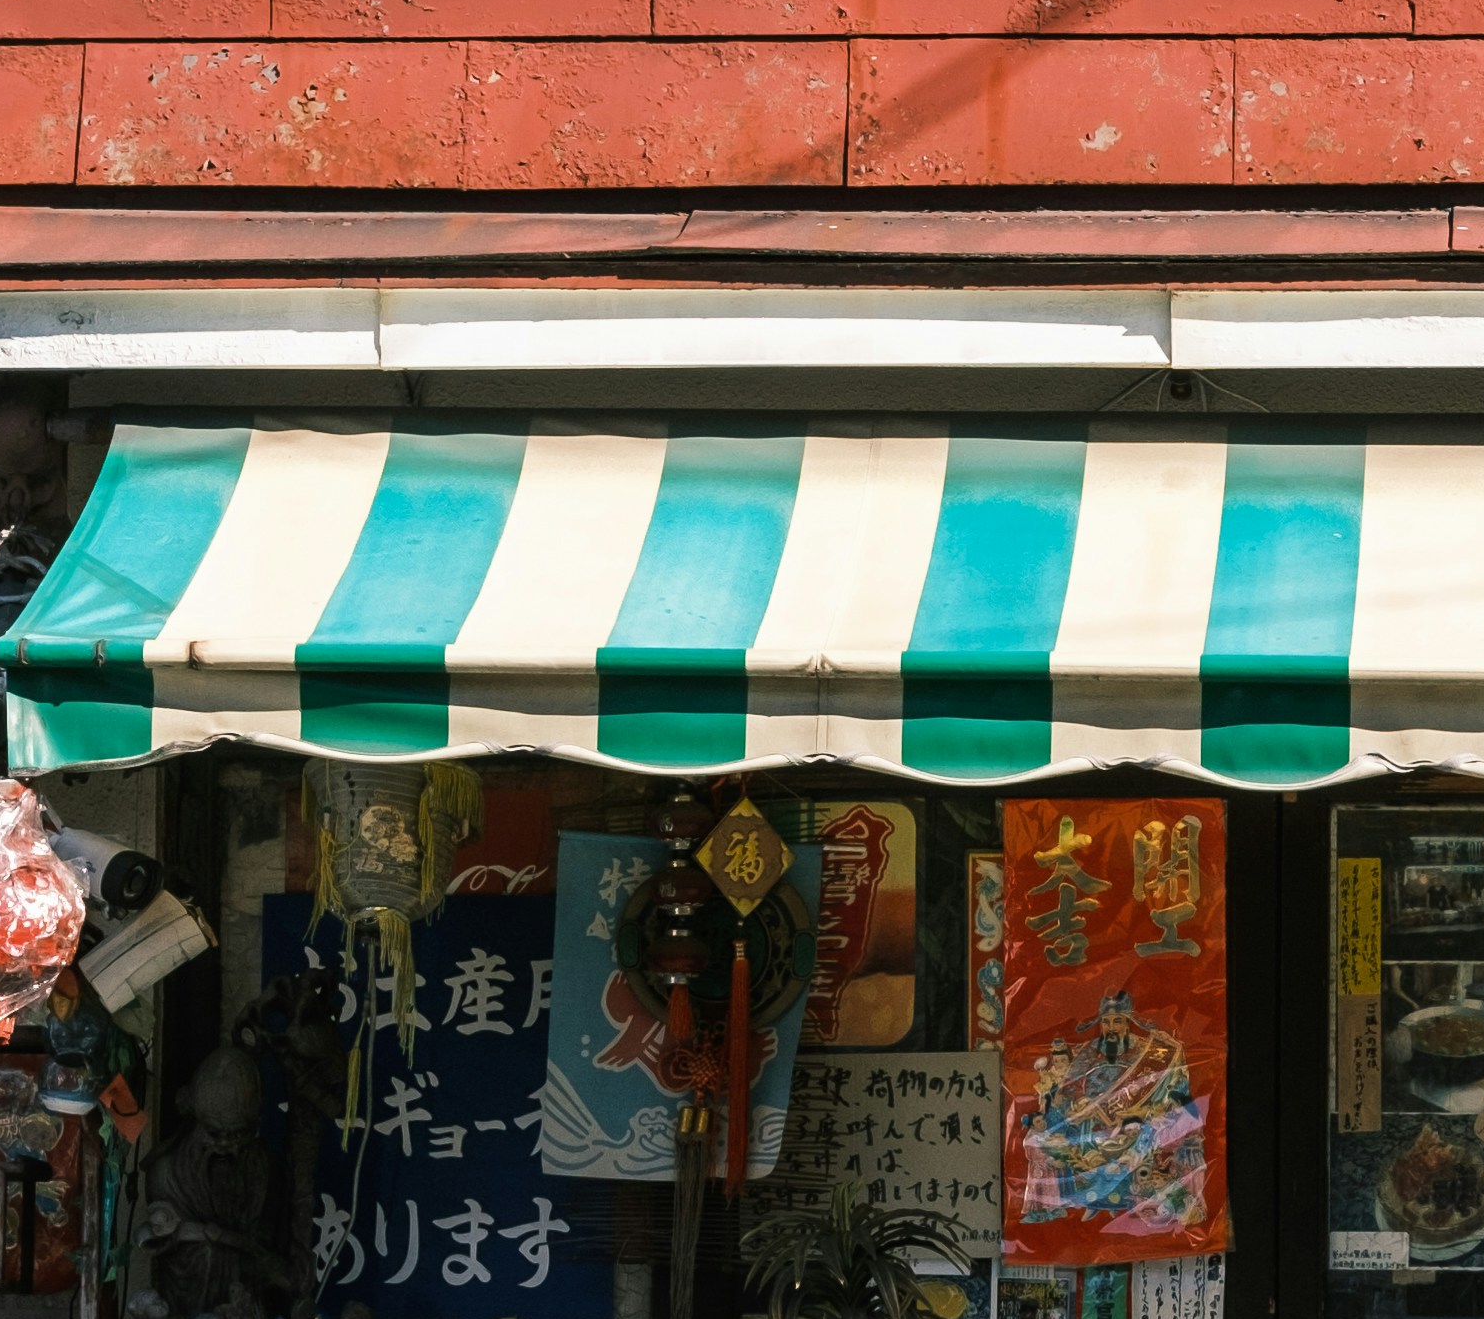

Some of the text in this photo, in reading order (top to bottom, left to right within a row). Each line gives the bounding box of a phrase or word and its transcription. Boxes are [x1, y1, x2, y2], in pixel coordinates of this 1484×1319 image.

[722, 829, 766, 885] 福
[1025, 814, 1113, 967] 大吉
[311, 1192, 571, 1289] あります
